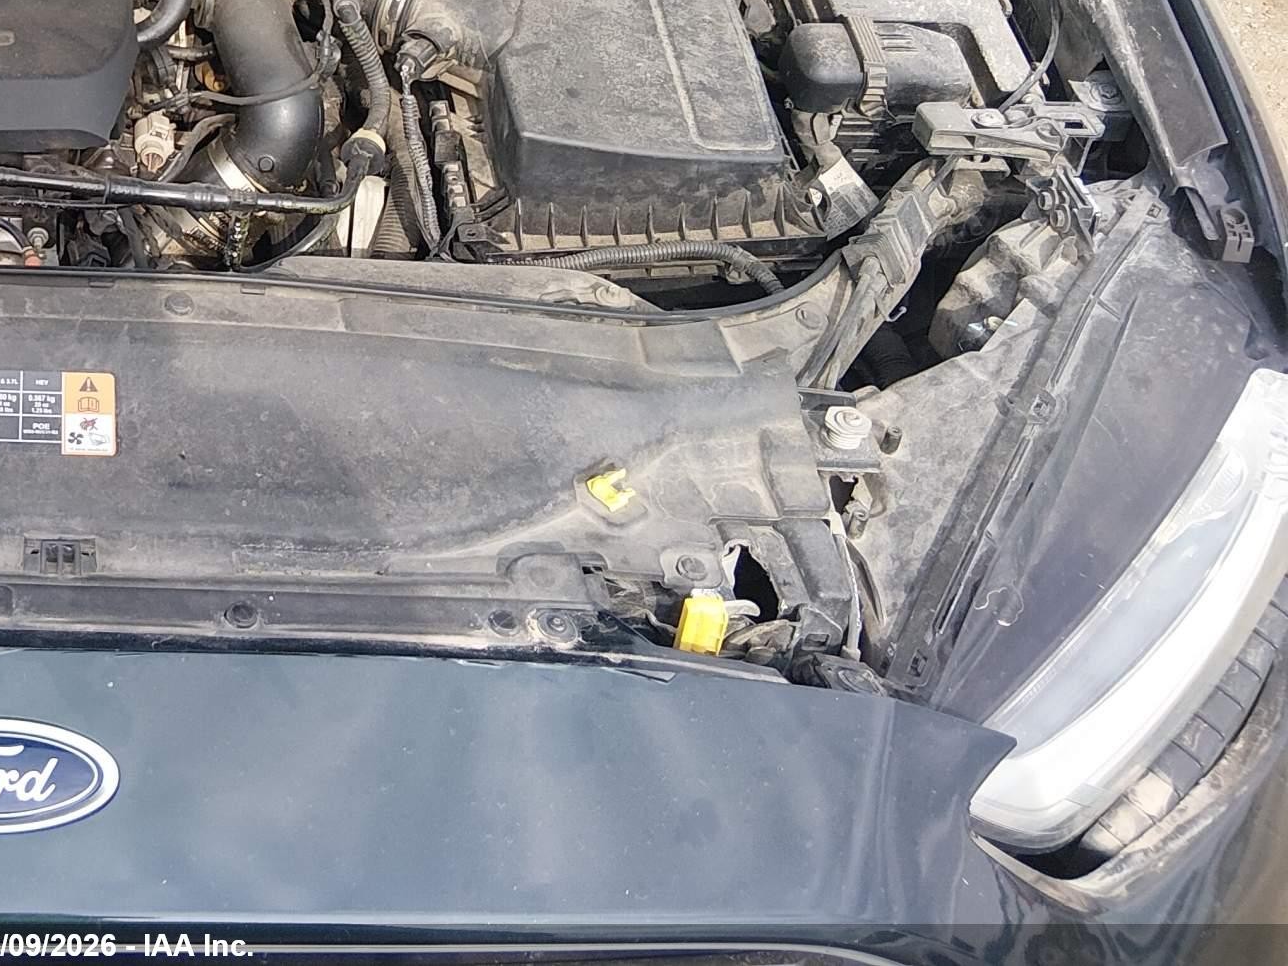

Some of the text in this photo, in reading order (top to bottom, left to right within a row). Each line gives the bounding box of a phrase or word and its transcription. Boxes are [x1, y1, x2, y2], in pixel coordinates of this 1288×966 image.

[7, 393, 17, 403] kg
[46, 395, 56, 404] kg
[32, 422, 50, 431] POE
